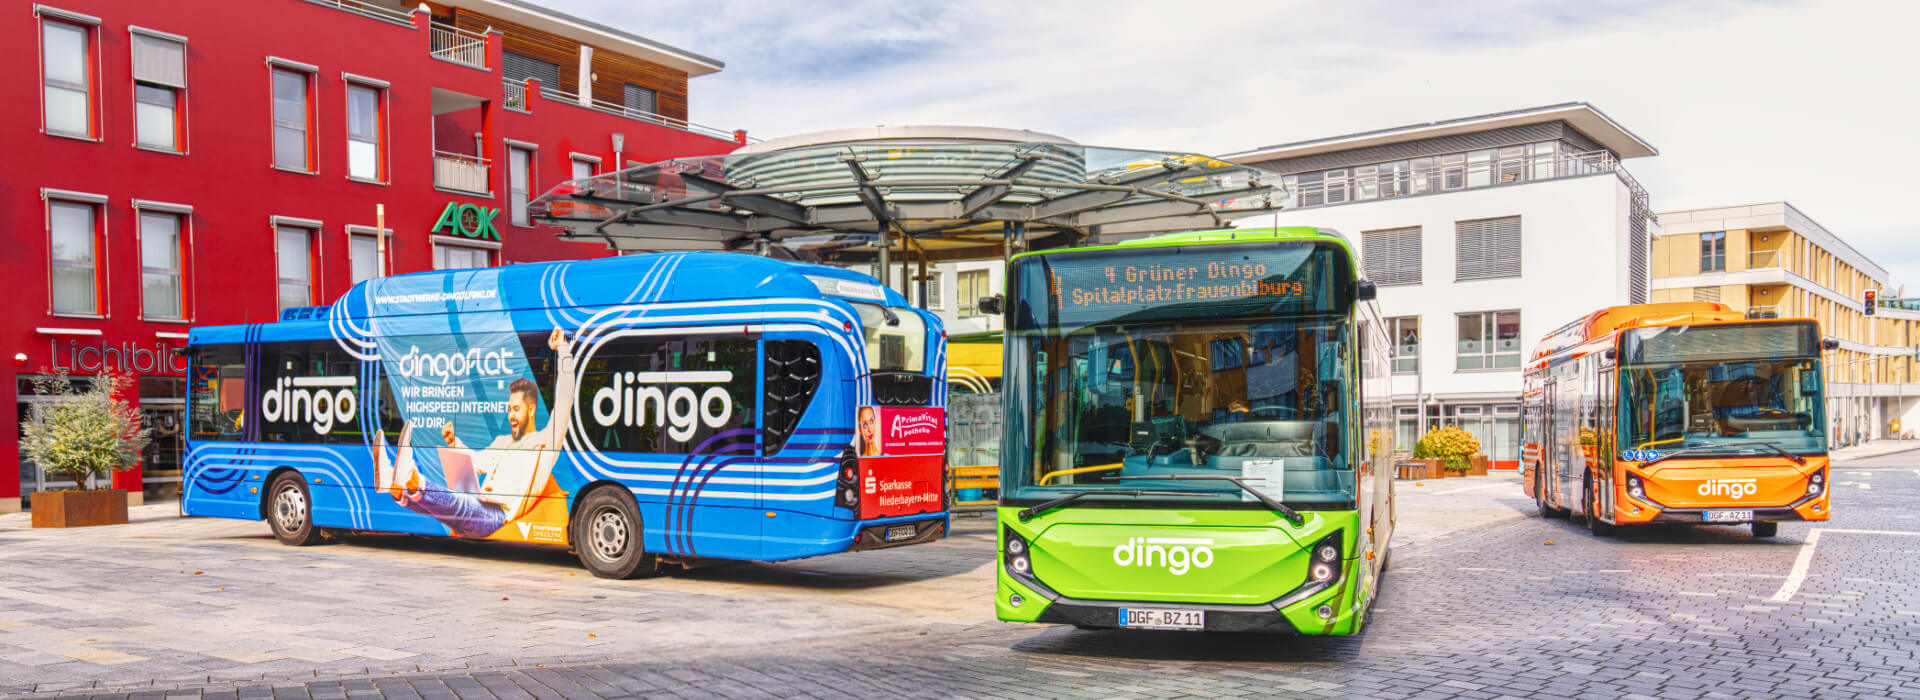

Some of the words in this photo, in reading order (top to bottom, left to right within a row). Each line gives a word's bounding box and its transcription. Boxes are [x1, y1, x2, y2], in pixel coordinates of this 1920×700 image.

[432, 201, 502, 240] AOK
[1105, 267, 1116, 284] 4
[1126, 265, 1198, 283] Grüner
[1208, 262, 1266, 279] Dingo
[1072, 279, 1304, 307] Spitalplatz-Frauenbiburg
[399, 345, 514, 386] dingoflat
[401, 386, 420, 398] WIR
[422, 385, 465, 398] BRINGEN
[262, 376, 357, 435] dingo
[406, 402, 460, 413] HIGHSPEED
[461, 401, 509, 413] INTERNET
[592, 370, 733, 442] dingo
[411, 417, 425, 428] ZU
[426, 416, 446, 429] DIR!
[880, 480, 912, 493] Sparkasse
[1698, 479, 1757, 498] dingo
[879, 492, 939, 507] Niederbayern-Mitte
[1113, 536, 1214, 575] dingo
[1128, 610, 1155, 625] DGF
[1163, 611, 1182, 626] BZ
[1184, 612, 1202, 627] 11
